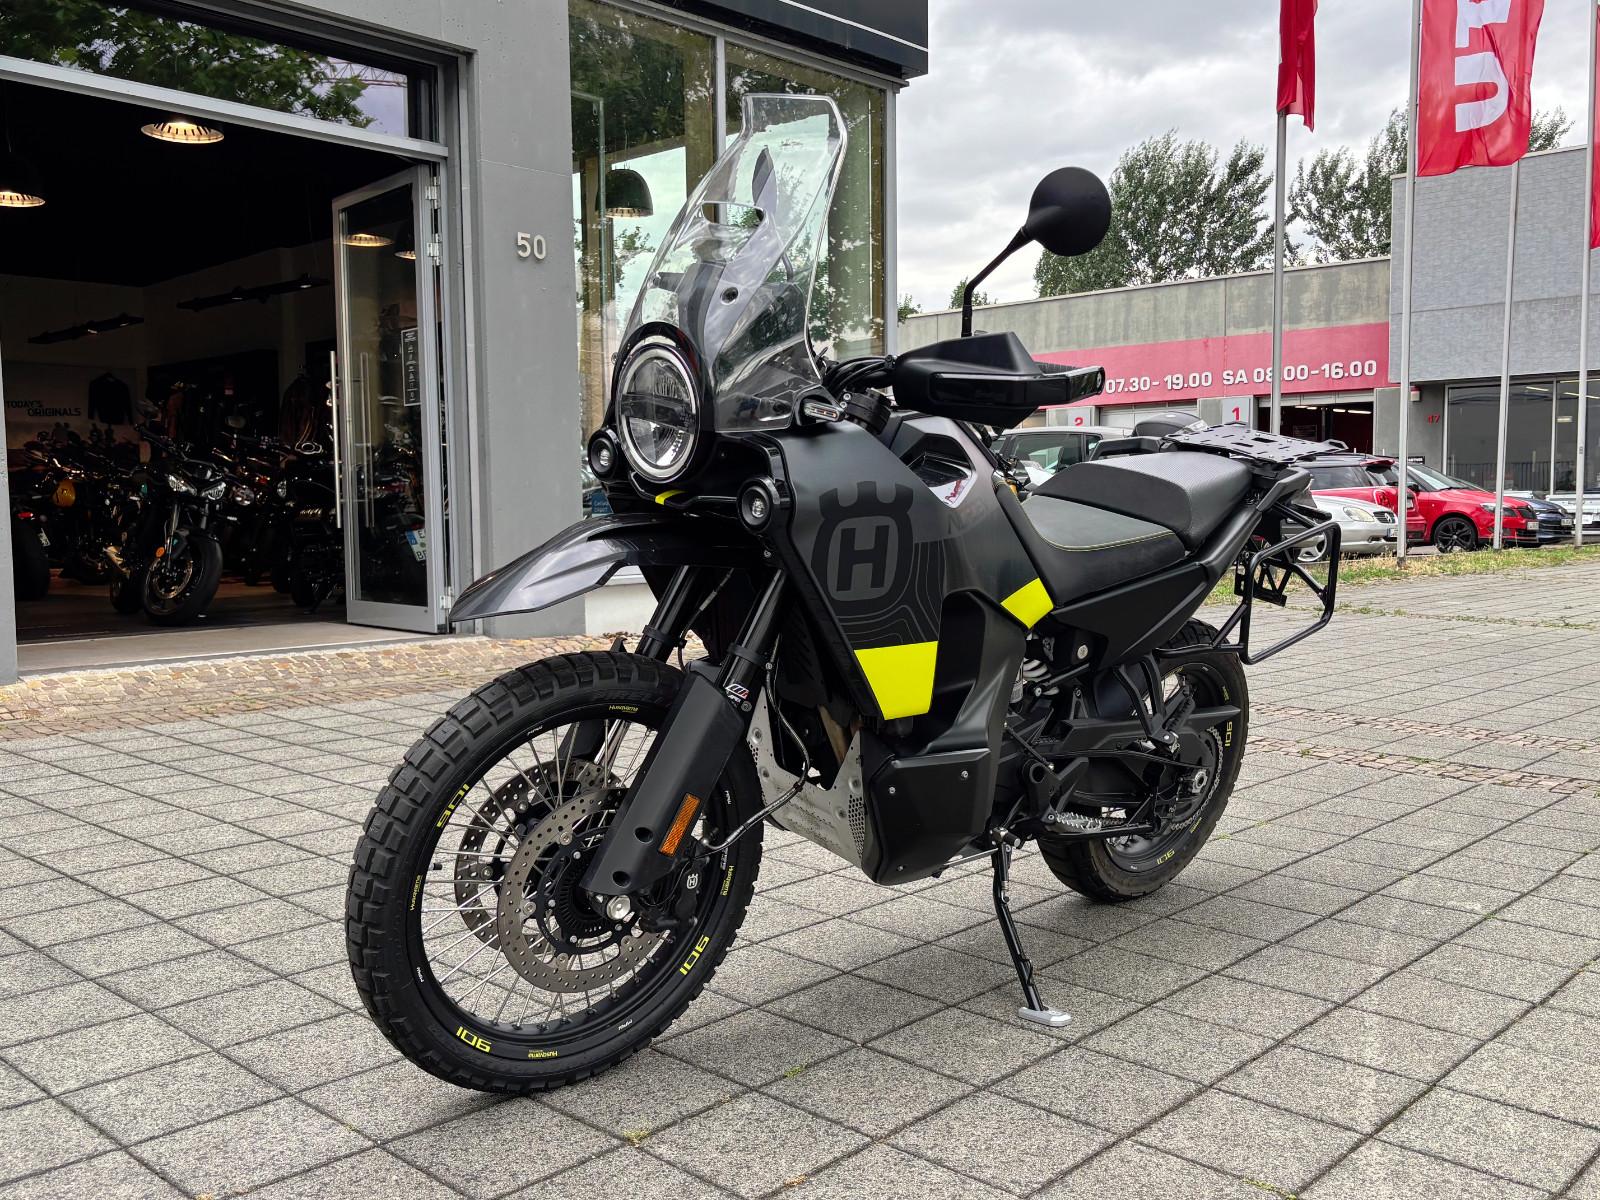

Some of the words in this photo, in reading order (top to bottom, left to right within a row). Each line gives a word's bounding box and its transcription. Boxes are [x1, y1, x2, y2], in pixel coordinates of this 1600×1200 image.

[517, 231, 546, 260] 50
[1222, 369, 1248, 385] SA
[27, 407, 82, 417] ORIGINALS
[1232, 407, 1240, 421] 1
[1224, 721, 1233, 747] 901
[436, 783, 470, 828] 901
[1156, 848, 1175, 865] 901
[679, 934, 710, 976] 901
[456, 1026, 492, 1053] 901
